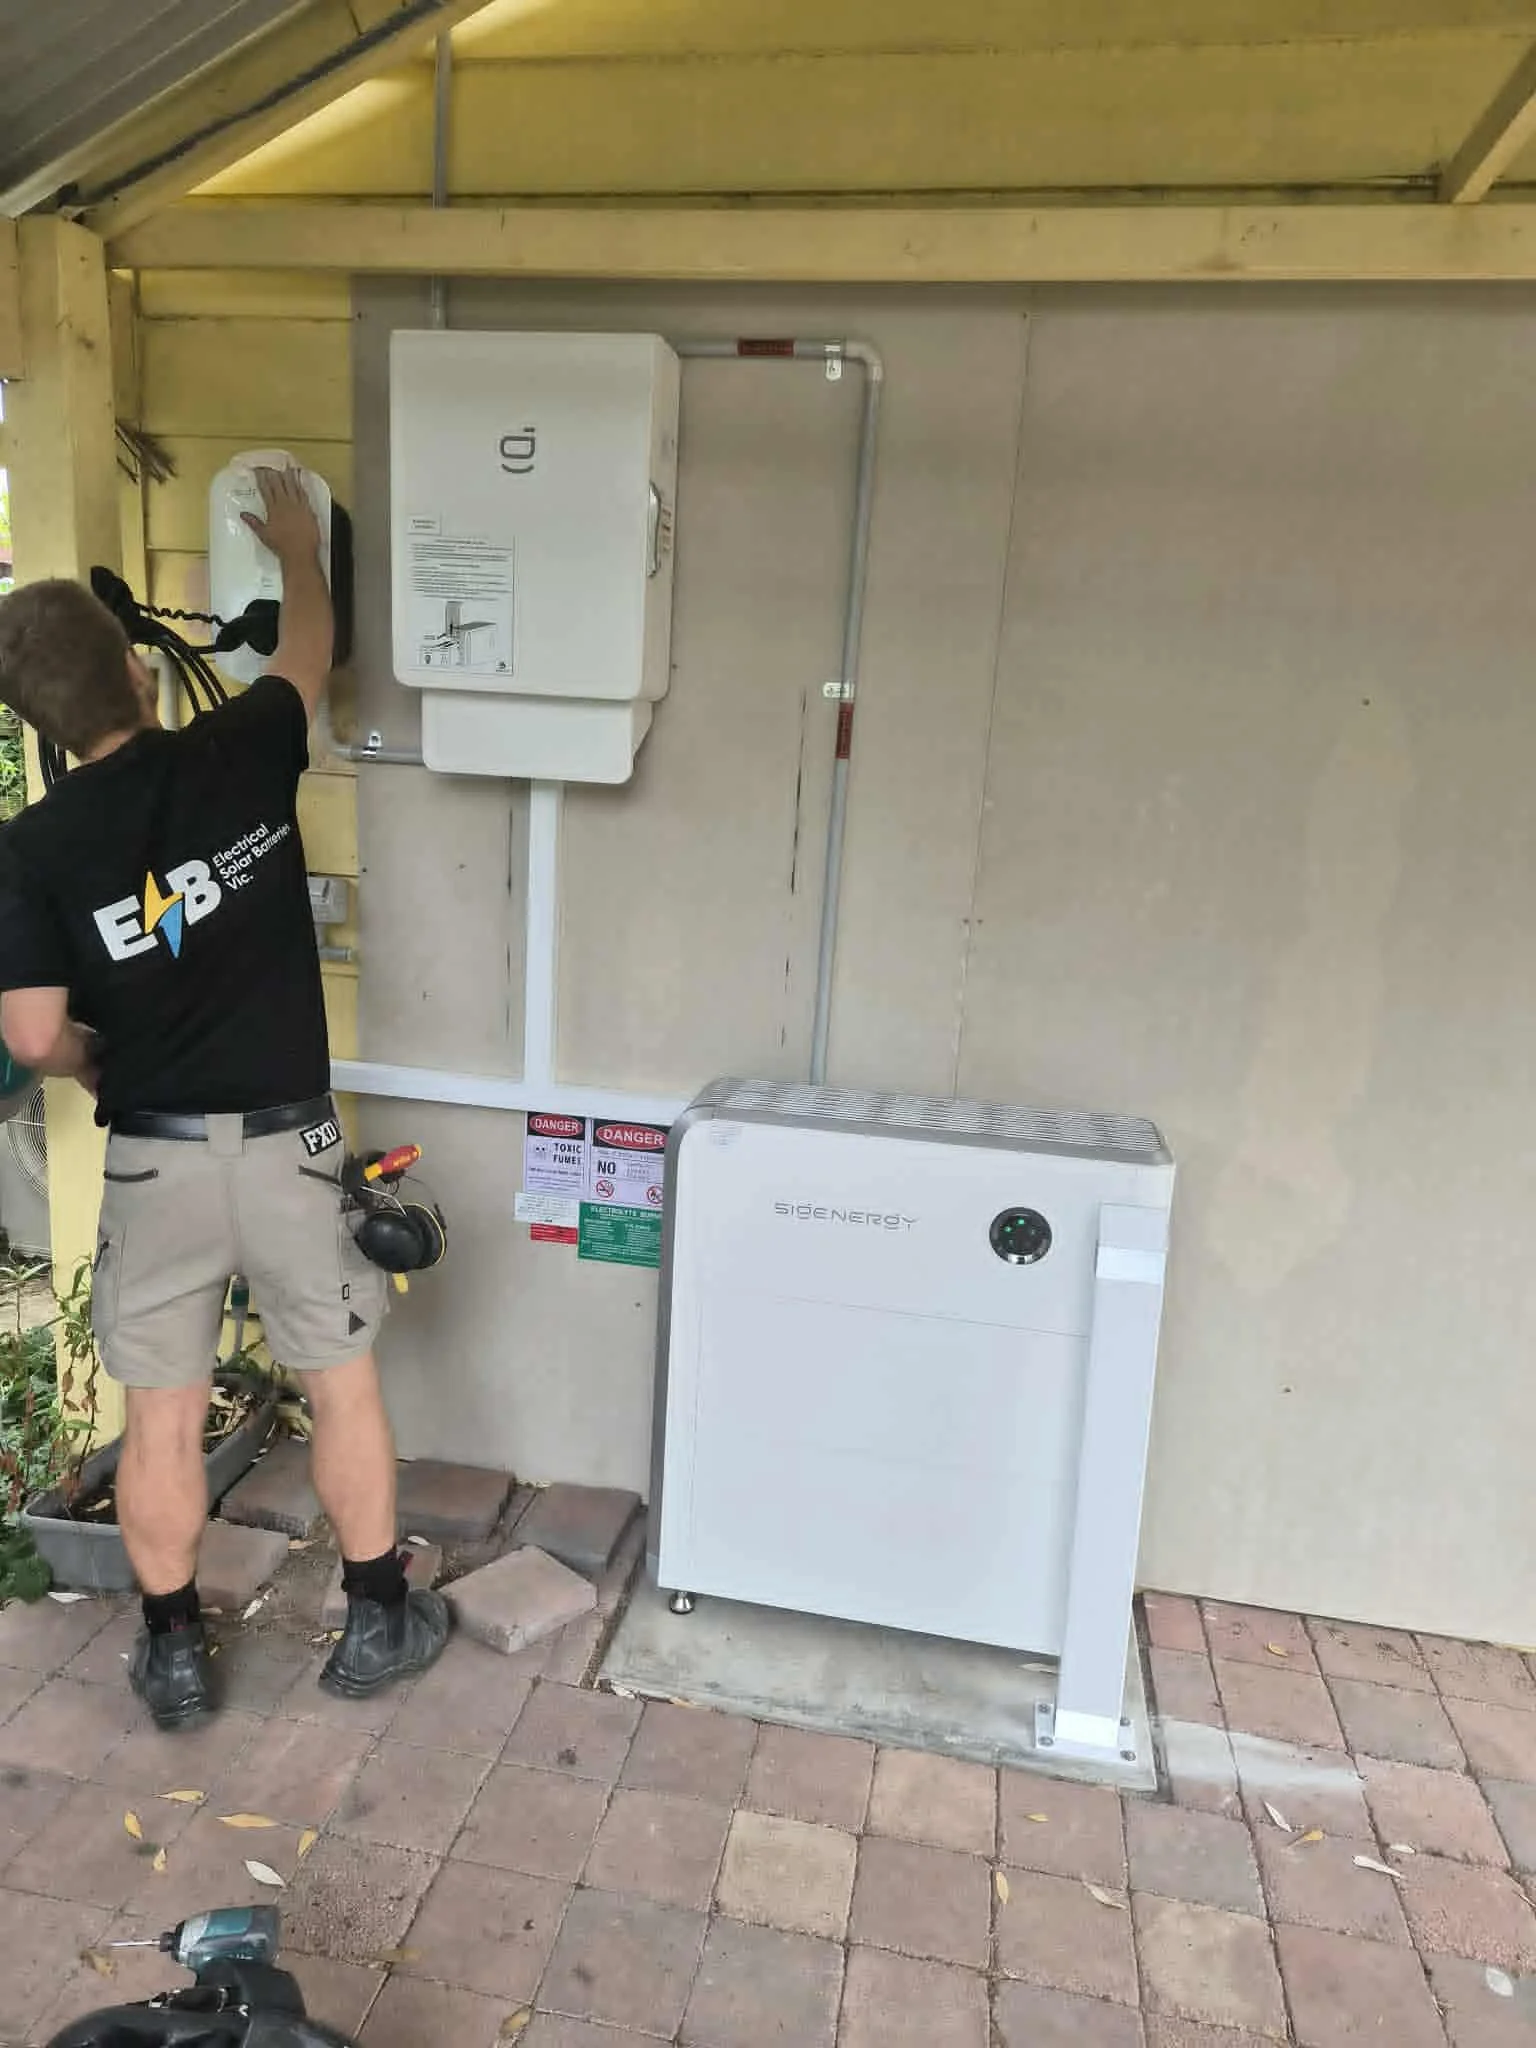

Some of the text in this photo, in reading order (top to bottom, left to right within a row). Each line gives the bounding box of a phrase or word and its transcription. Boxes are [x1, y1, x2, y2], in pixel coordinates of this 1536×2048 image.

[212, 823, 270, 868] Electrical
[219, 853, 253, 880] Solar
[225, 873, 254, 890] Vic.
[535, 1117, 579, 1133] DANGER
[304, 1119, 338, 1154] FXD
[603, 1128, 664, 1146] DANGER
[553, 1142, 582, 1154] TOXIC
[597, 1160, 617, 1175] NO
[774, 1202, 920, 1233] SIGENERGY
